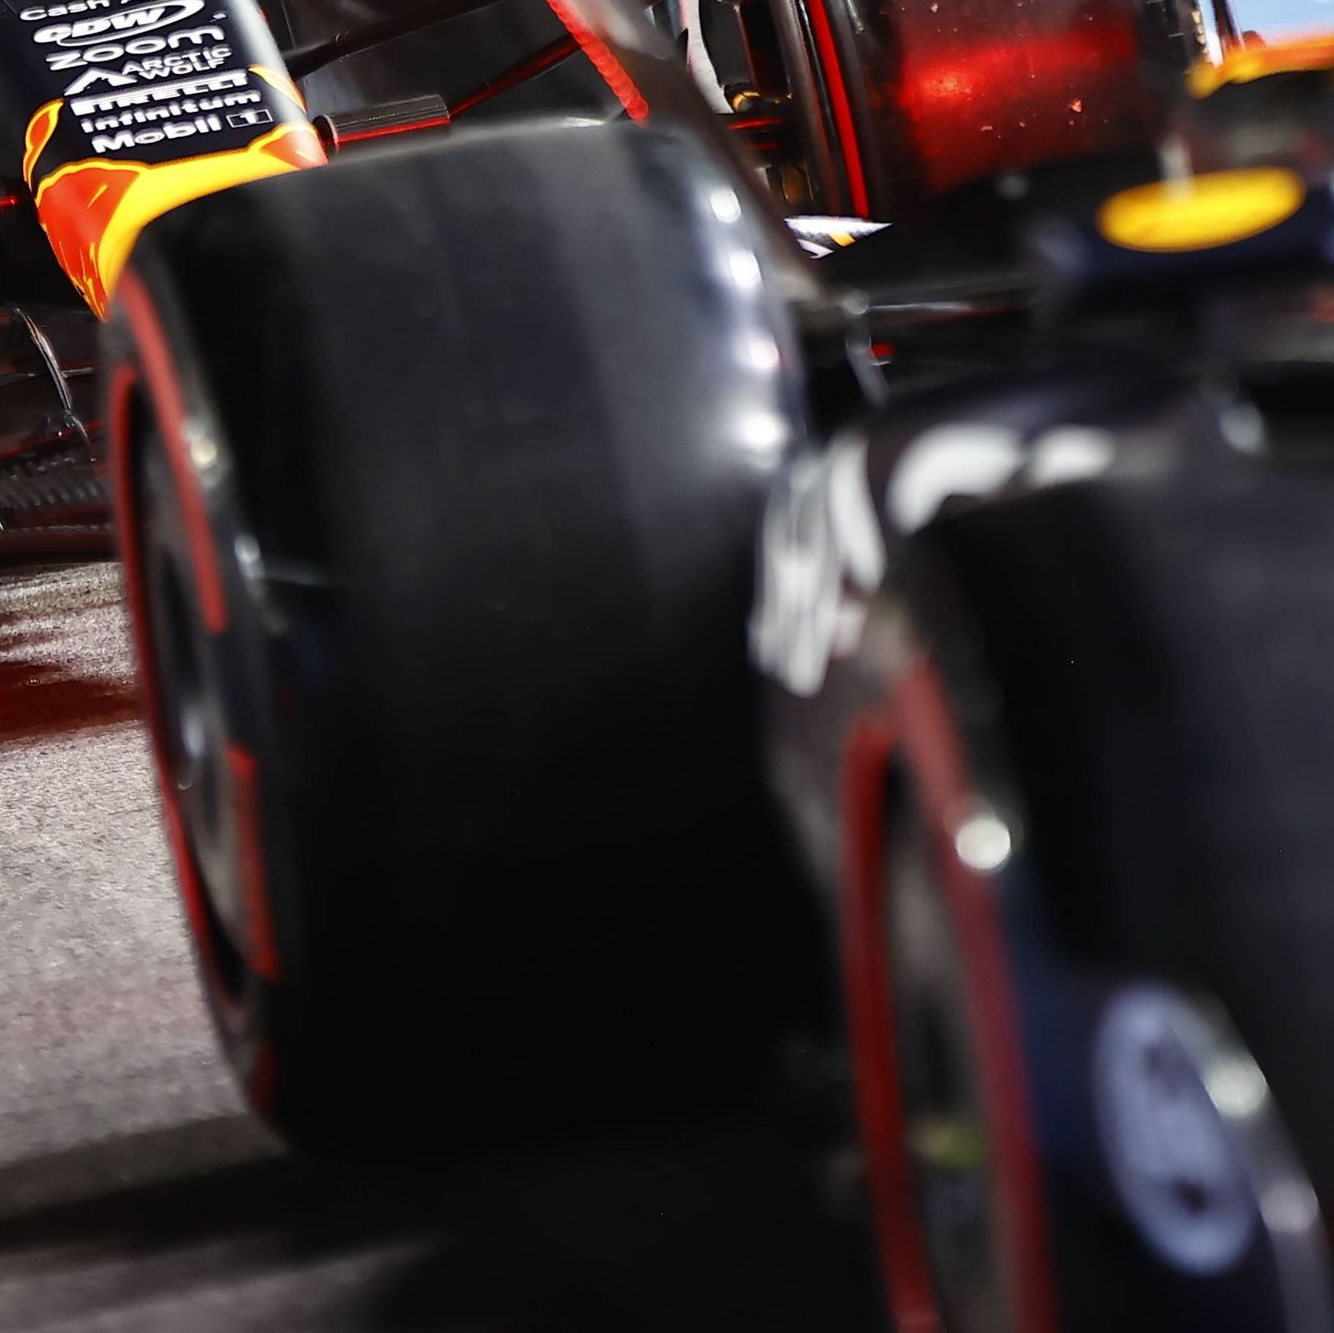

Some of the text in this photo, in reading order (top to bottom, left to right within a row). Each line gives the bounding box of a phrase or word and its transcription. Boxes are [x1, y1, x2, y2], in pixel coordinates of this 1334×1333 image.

[122, 44, 233, 75] ARCTIC
[139, 57, 225, 80] WOLF
[80, 90, 262, 133] infinitum
[91, 114, 223, 153] Mobil
